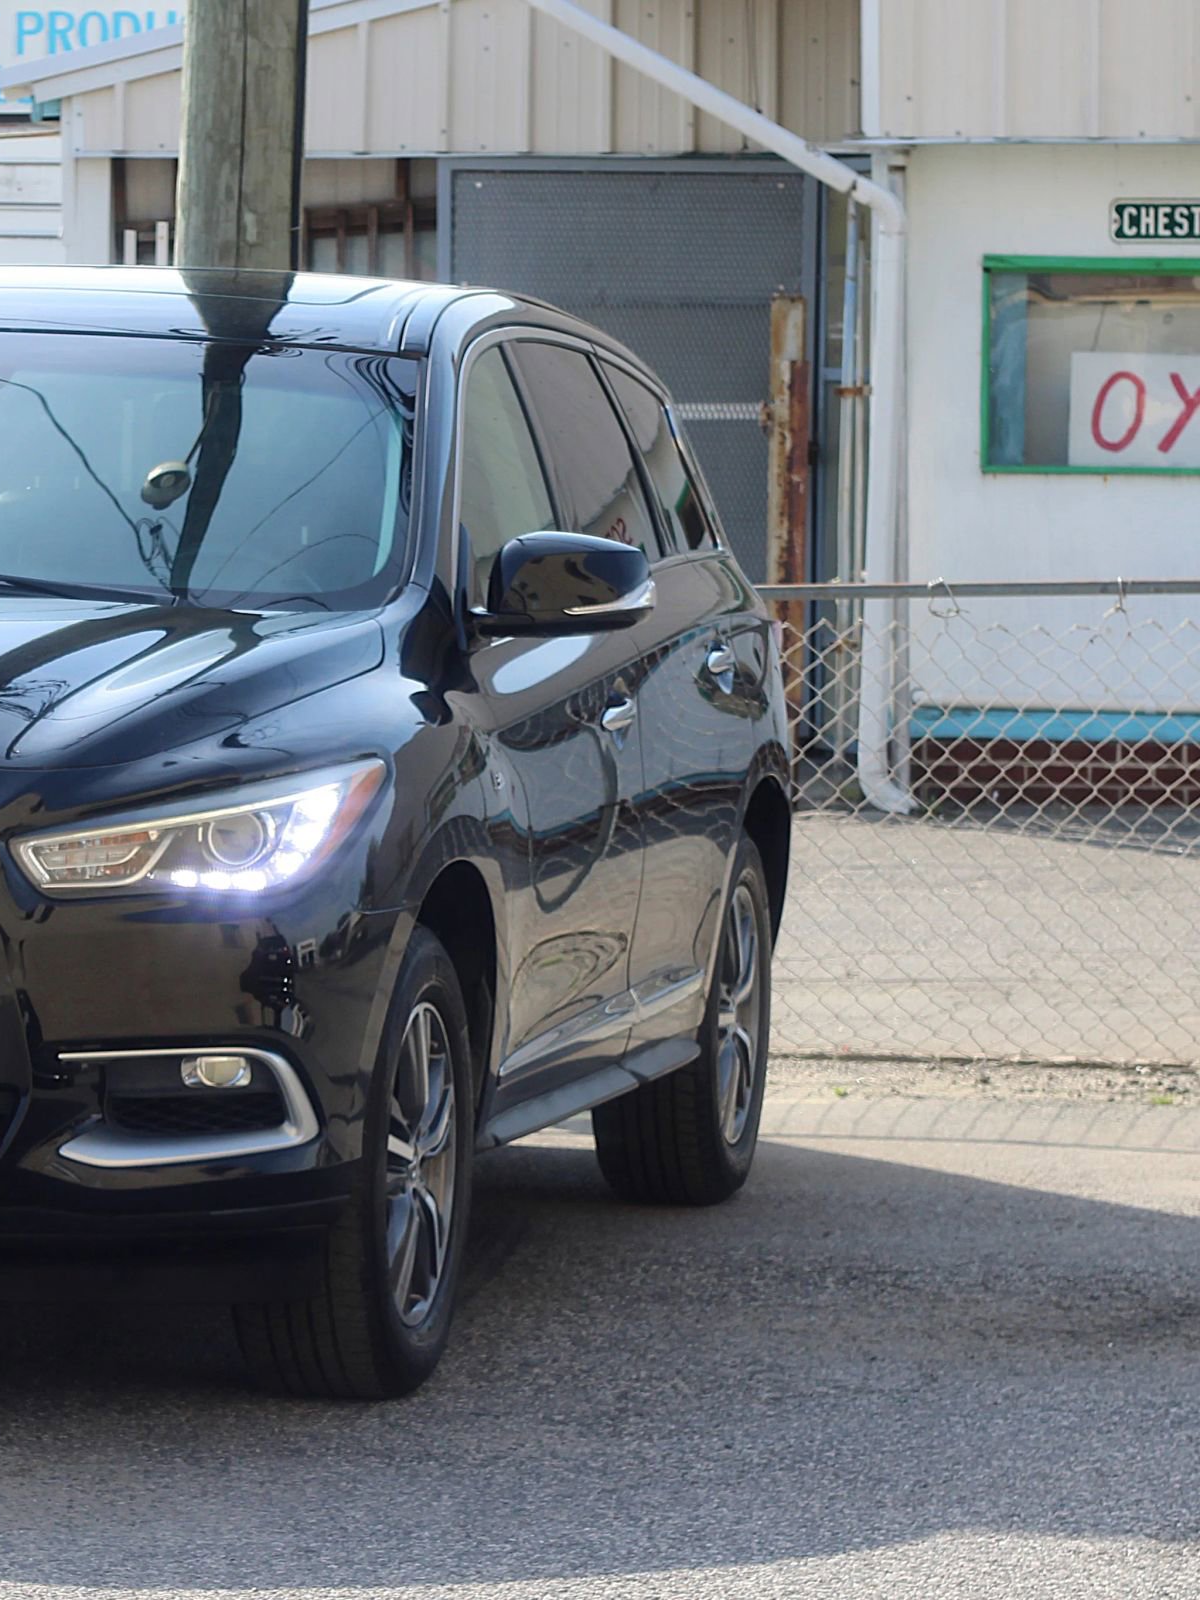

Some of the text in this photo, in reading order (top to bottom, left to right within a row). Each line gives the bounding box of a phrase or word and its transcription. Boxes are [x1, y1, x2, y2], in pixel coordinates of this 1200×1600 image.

[16, 10, 184, 52] PROD
[1122, 205, 1200, 237] CHEST
[1090, 370, 1200, 454] OY
